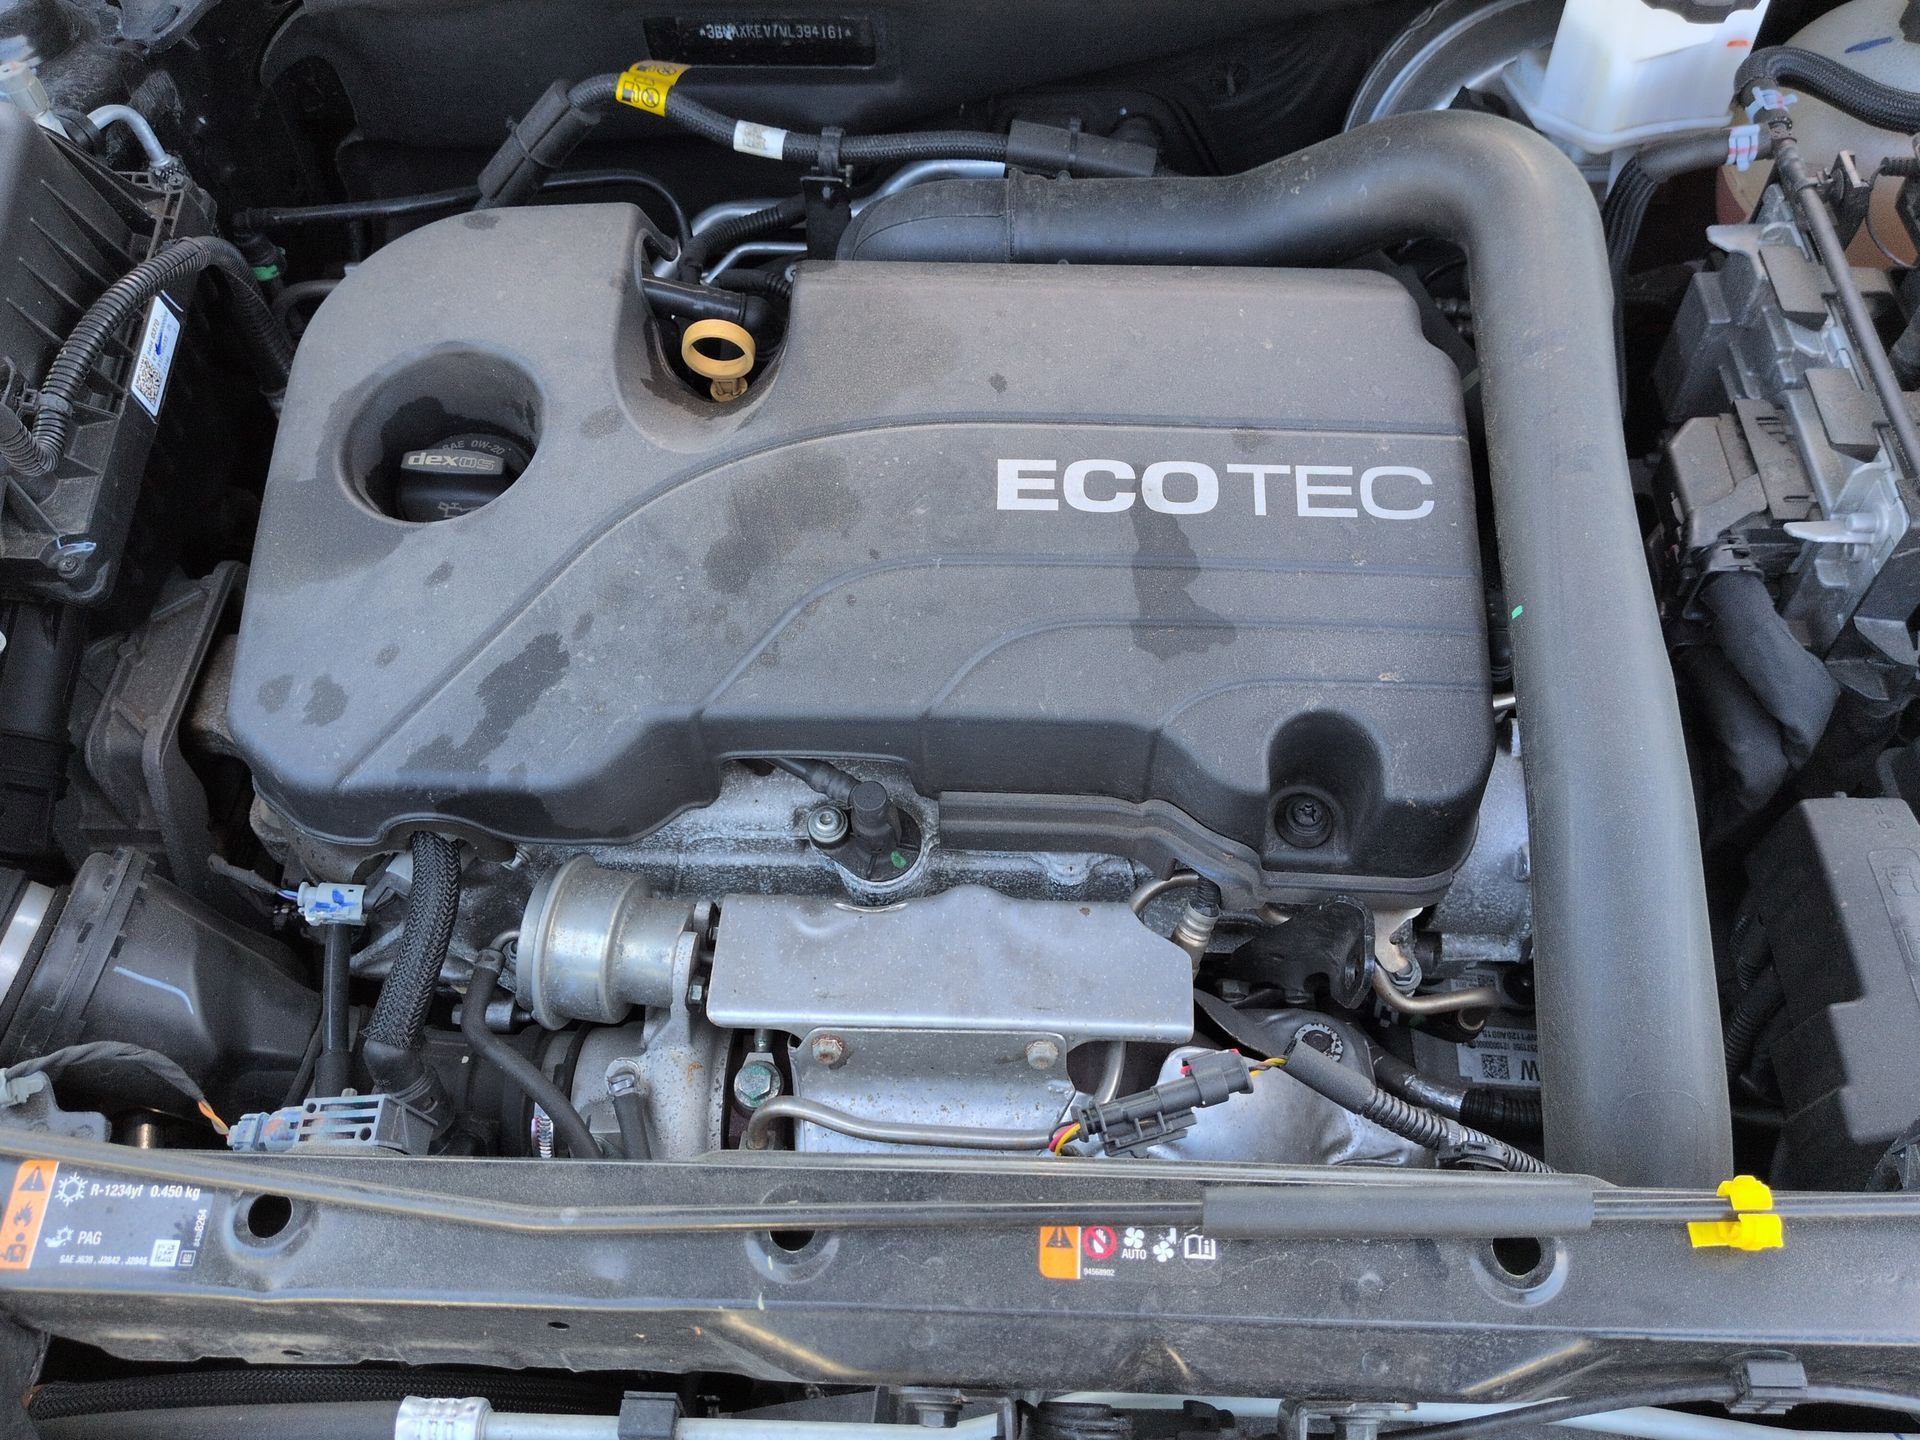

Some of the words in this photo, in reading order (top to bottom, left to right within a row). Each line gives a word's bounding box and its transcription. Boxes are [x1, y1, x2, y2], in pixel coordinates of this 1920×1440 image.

[996, 458, 1435, 520] ECOTEC
[90, 1183, 143, 1199] R-1234yf
[150, 1185, 183, 1198] 0.450
[184, 1186, 201, 1201] kg
[77, 1231, 102, 1245] PAG
[1121, 1248, 1147, 1260] AUTO
